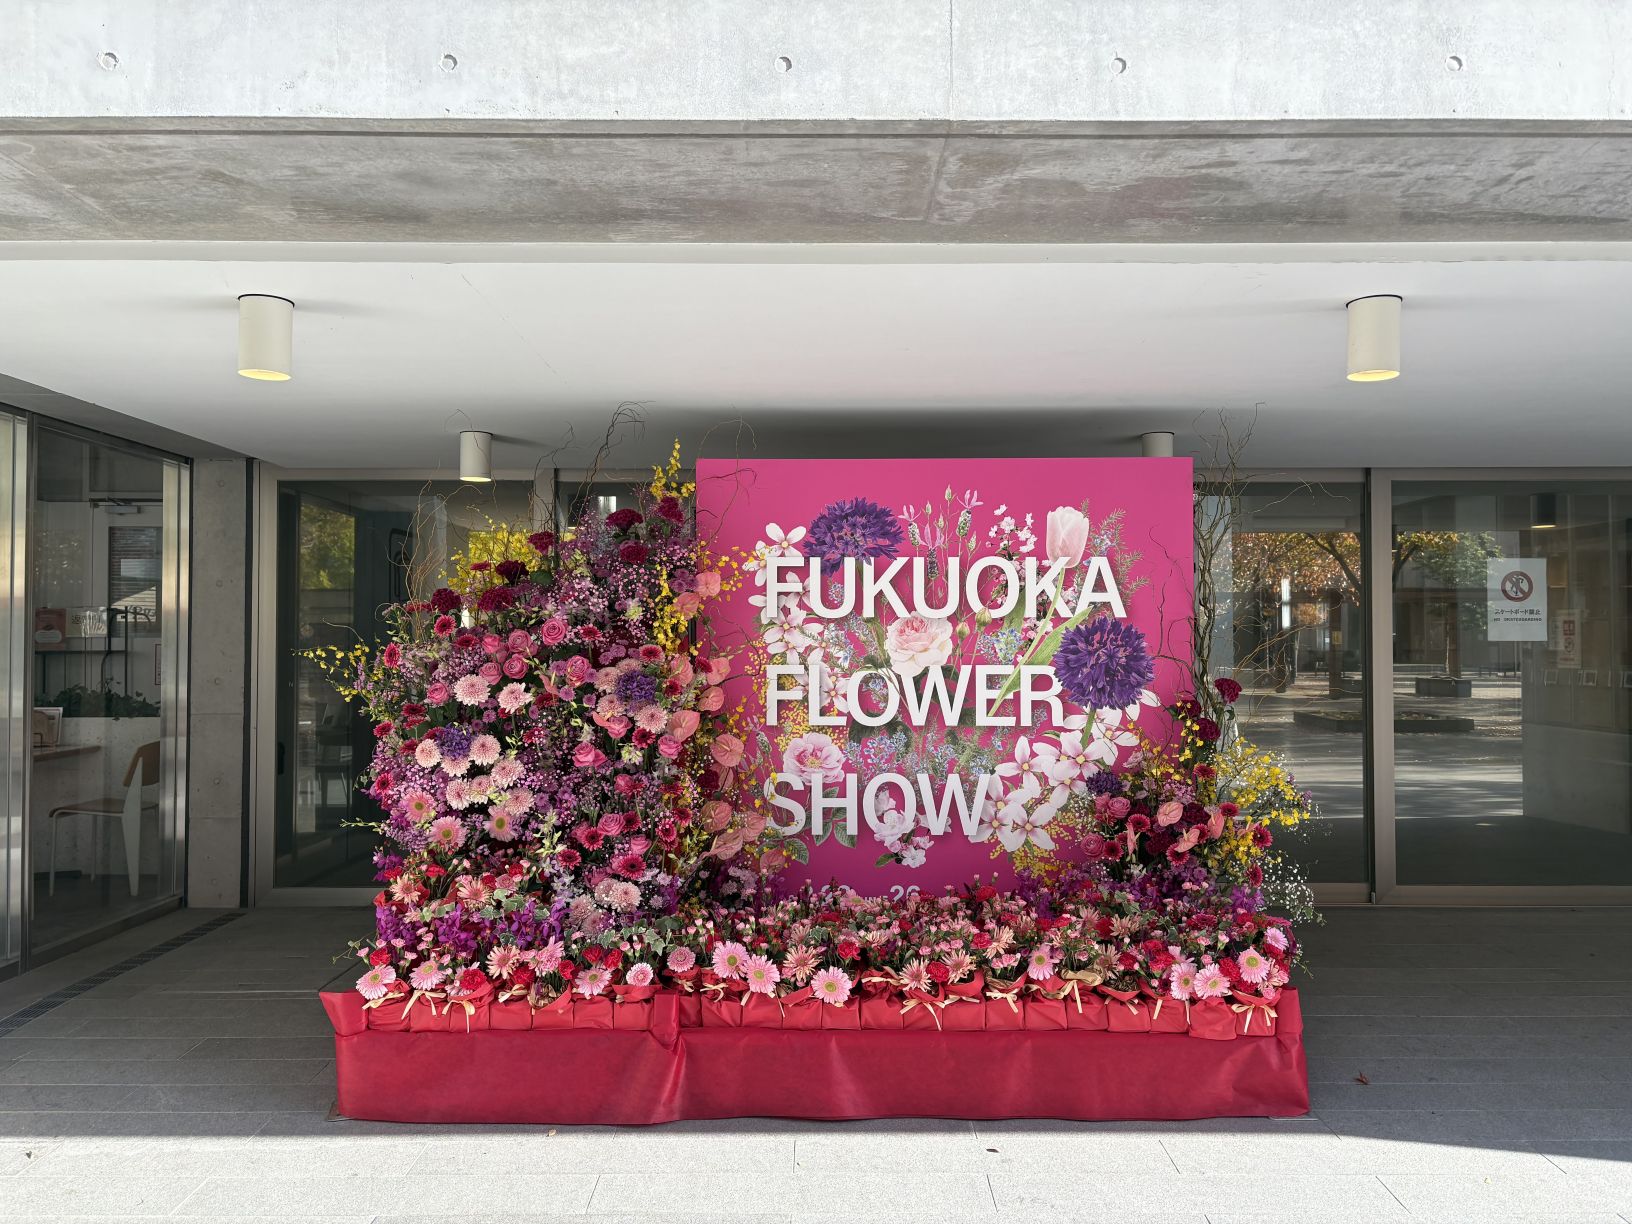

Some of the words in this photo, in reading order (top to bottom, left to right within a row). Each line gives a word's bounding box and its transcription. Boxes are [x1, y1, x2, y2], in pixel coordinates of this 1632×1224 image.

[766, 556, 1127, 618] FUKUOKA
[766, 665, 1064, 727] FLOWER
[765, 772, 991, 837] SHOW
